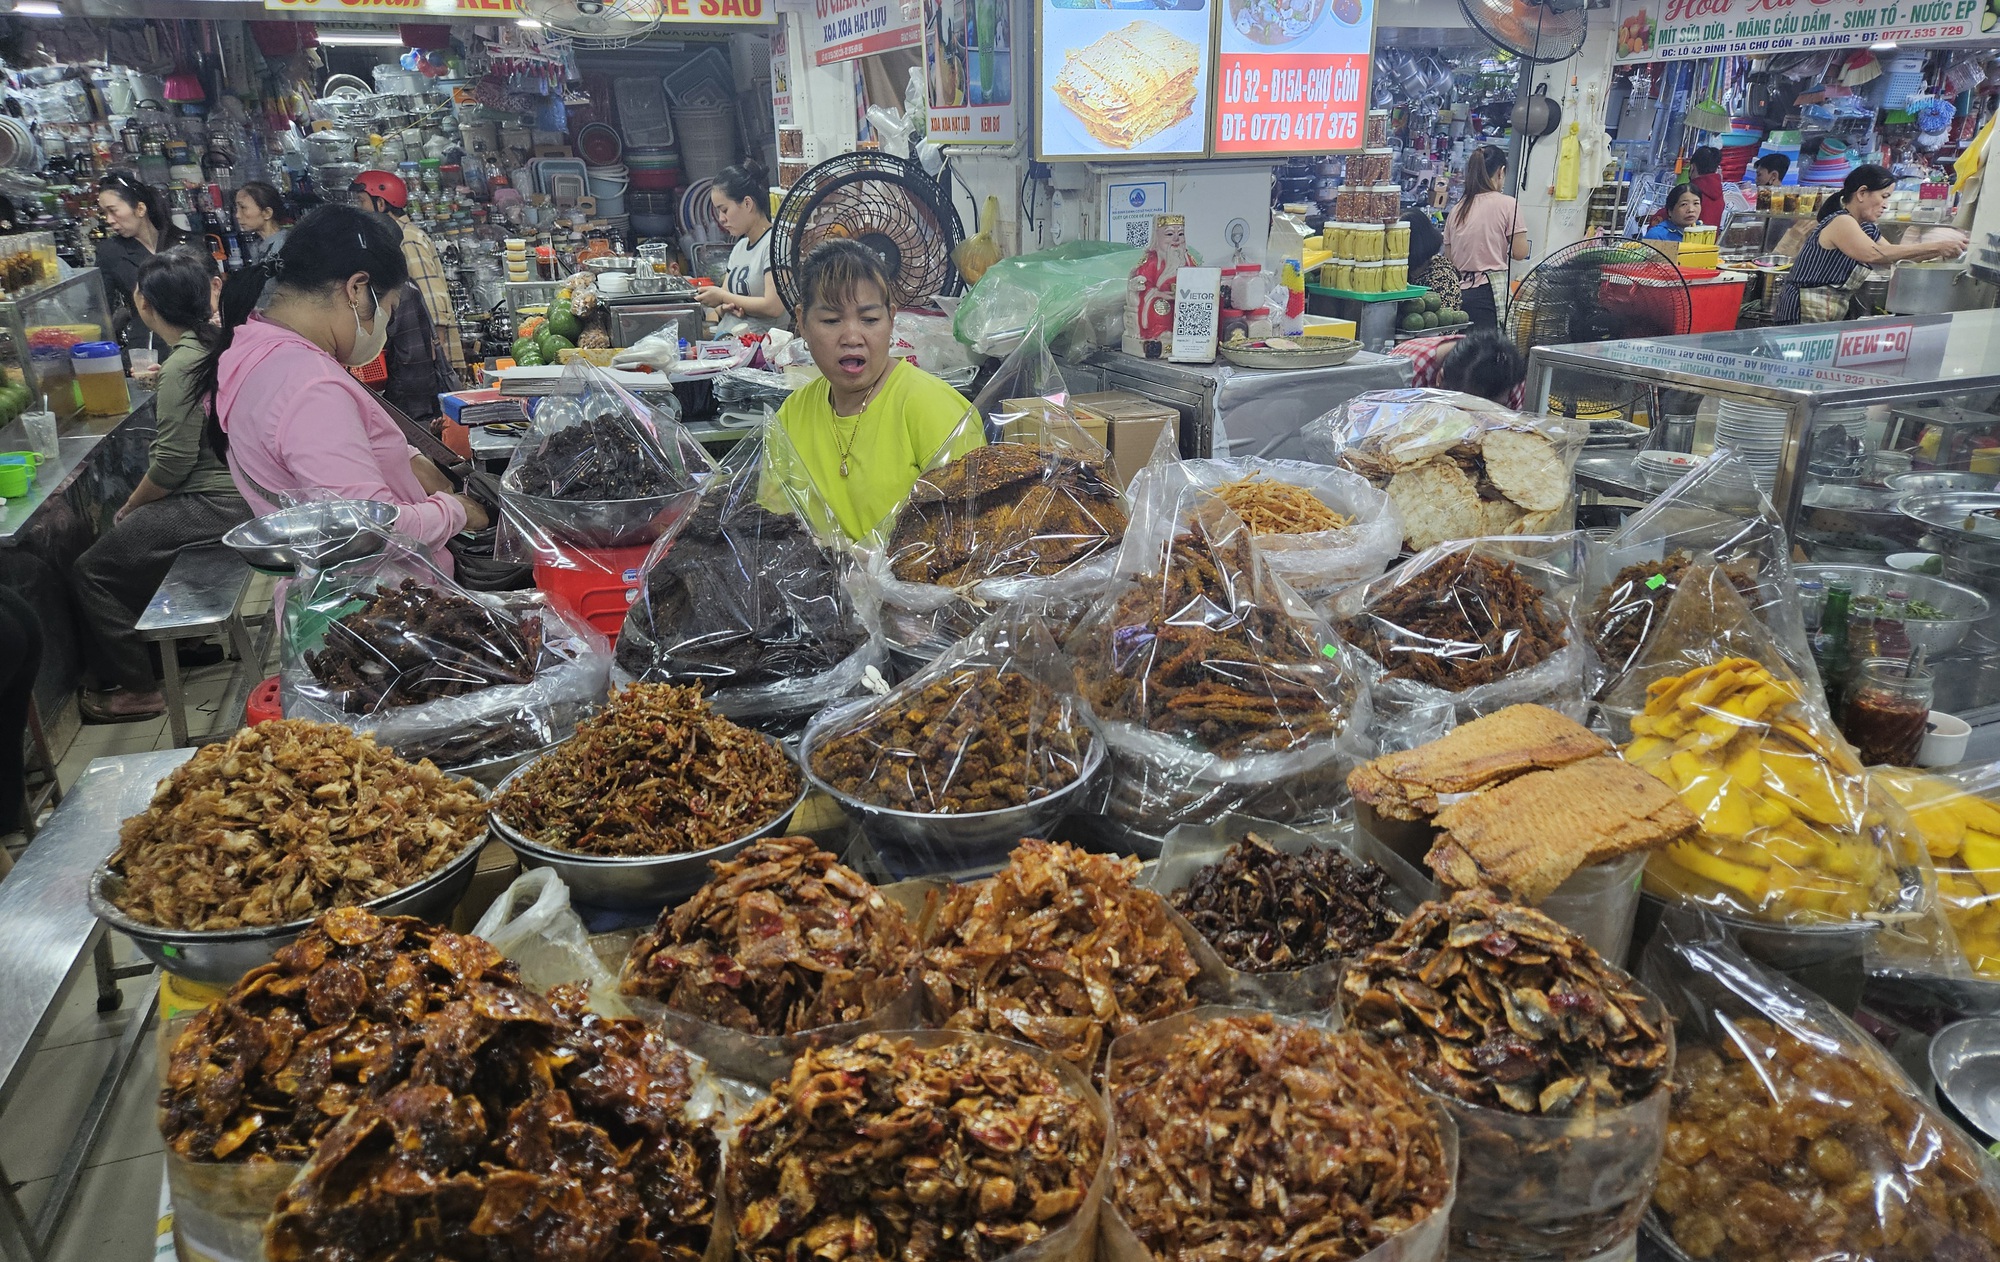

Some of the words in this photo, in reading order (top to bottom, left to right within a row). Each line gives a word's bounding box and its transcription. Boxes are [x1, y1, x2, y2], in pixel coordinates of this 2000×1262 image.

[823, 22, 837, 43] XOA
[838, 17, 853, 39] XOA
[854, 11, 868, 37] HẠT
[1658, 25, 1677, 45] MÍT
[1679, 24, 1700, 43] SỮA
[1703, 21, 1725, 41] DỪA
[1736, 17, 1771, 38] MÃNG
[1843, 9, 1877, 29] SINH
[1880, 0, 1899, 26] TỐ
[1662, 49, 1676, 57] ĐC:
[1678, 46, 1689, 56] LÔ
[1691, 46, 1702, 54] 42
[1730, 43, 1746, 52] 15A
[1749, 40, 1770, 51] CHỢ
[1802, 35, 1816, 46] ĐÀ
[1862, 32, 1879, 42] ĐT:
[1881, 28, 1936, 41] 0777.535
[1941, 26, 1964, 36] 729
[1224, 61, 1242, 103] LÔ
[1243, 68, 1261, 103] 32
[980, 116, 992, 132] KEM
[1222, 113, 1247, 142] ĐT:
[1250, 113, 1291, 141] 0779
[1294, 112, 1325, 140] 417
[1328, 112, 1357, 139] 375
[1180, 289, 1215, 300] VIETQR
